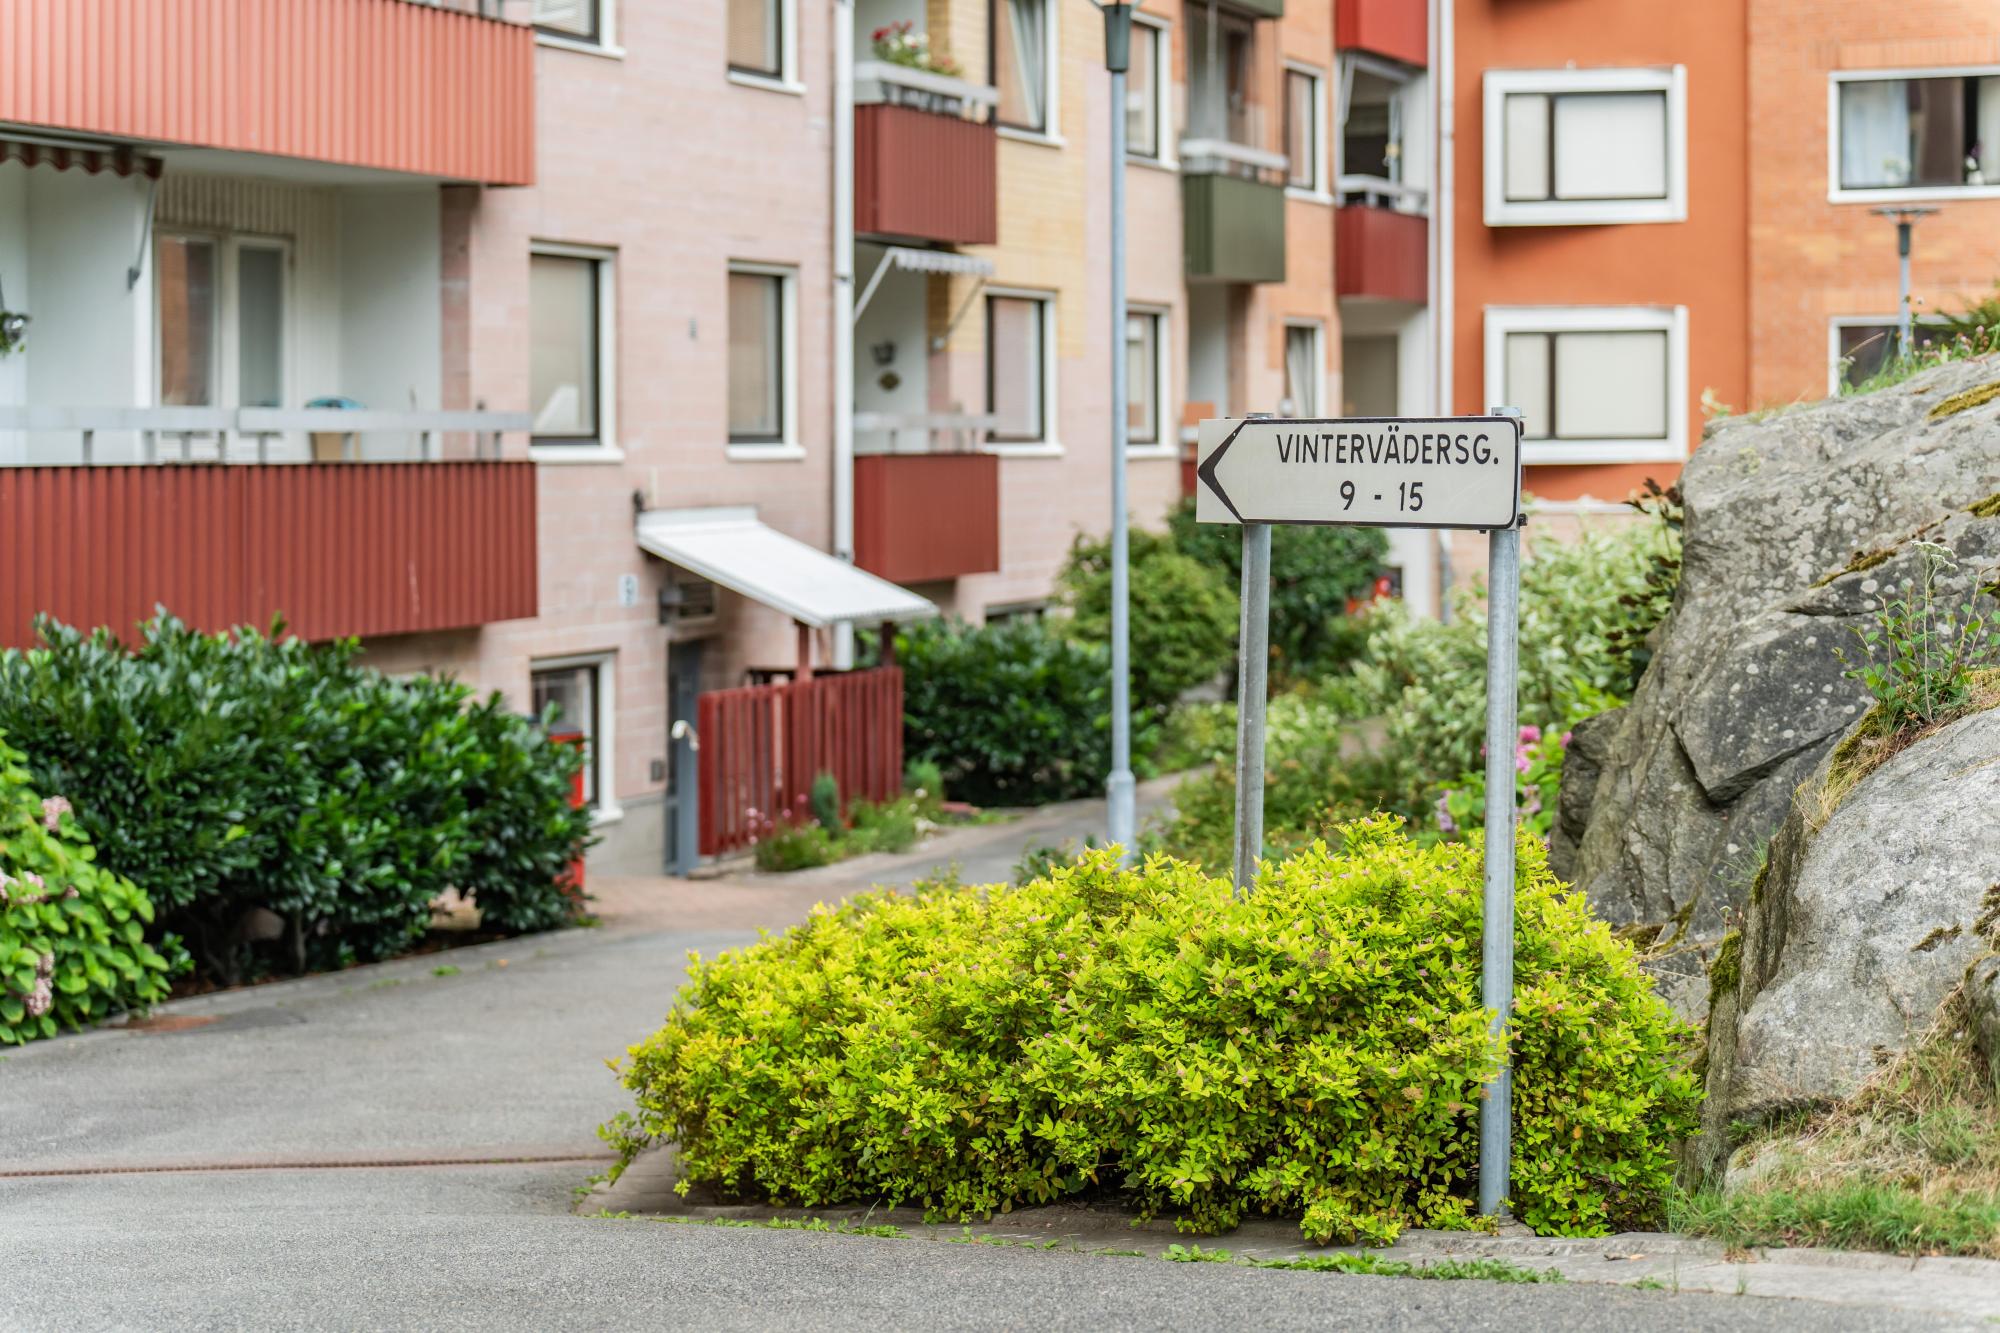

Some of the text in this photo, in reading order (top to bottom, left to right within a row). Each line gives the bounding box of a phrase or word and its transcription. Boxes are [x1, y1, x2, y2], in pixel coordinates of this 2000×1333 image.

[1276, 425, 1499, 465] VINTERVÄDERSG.
[1340, 480, 1356, 511] 9
[1399, 481, 1424, 512] 15
